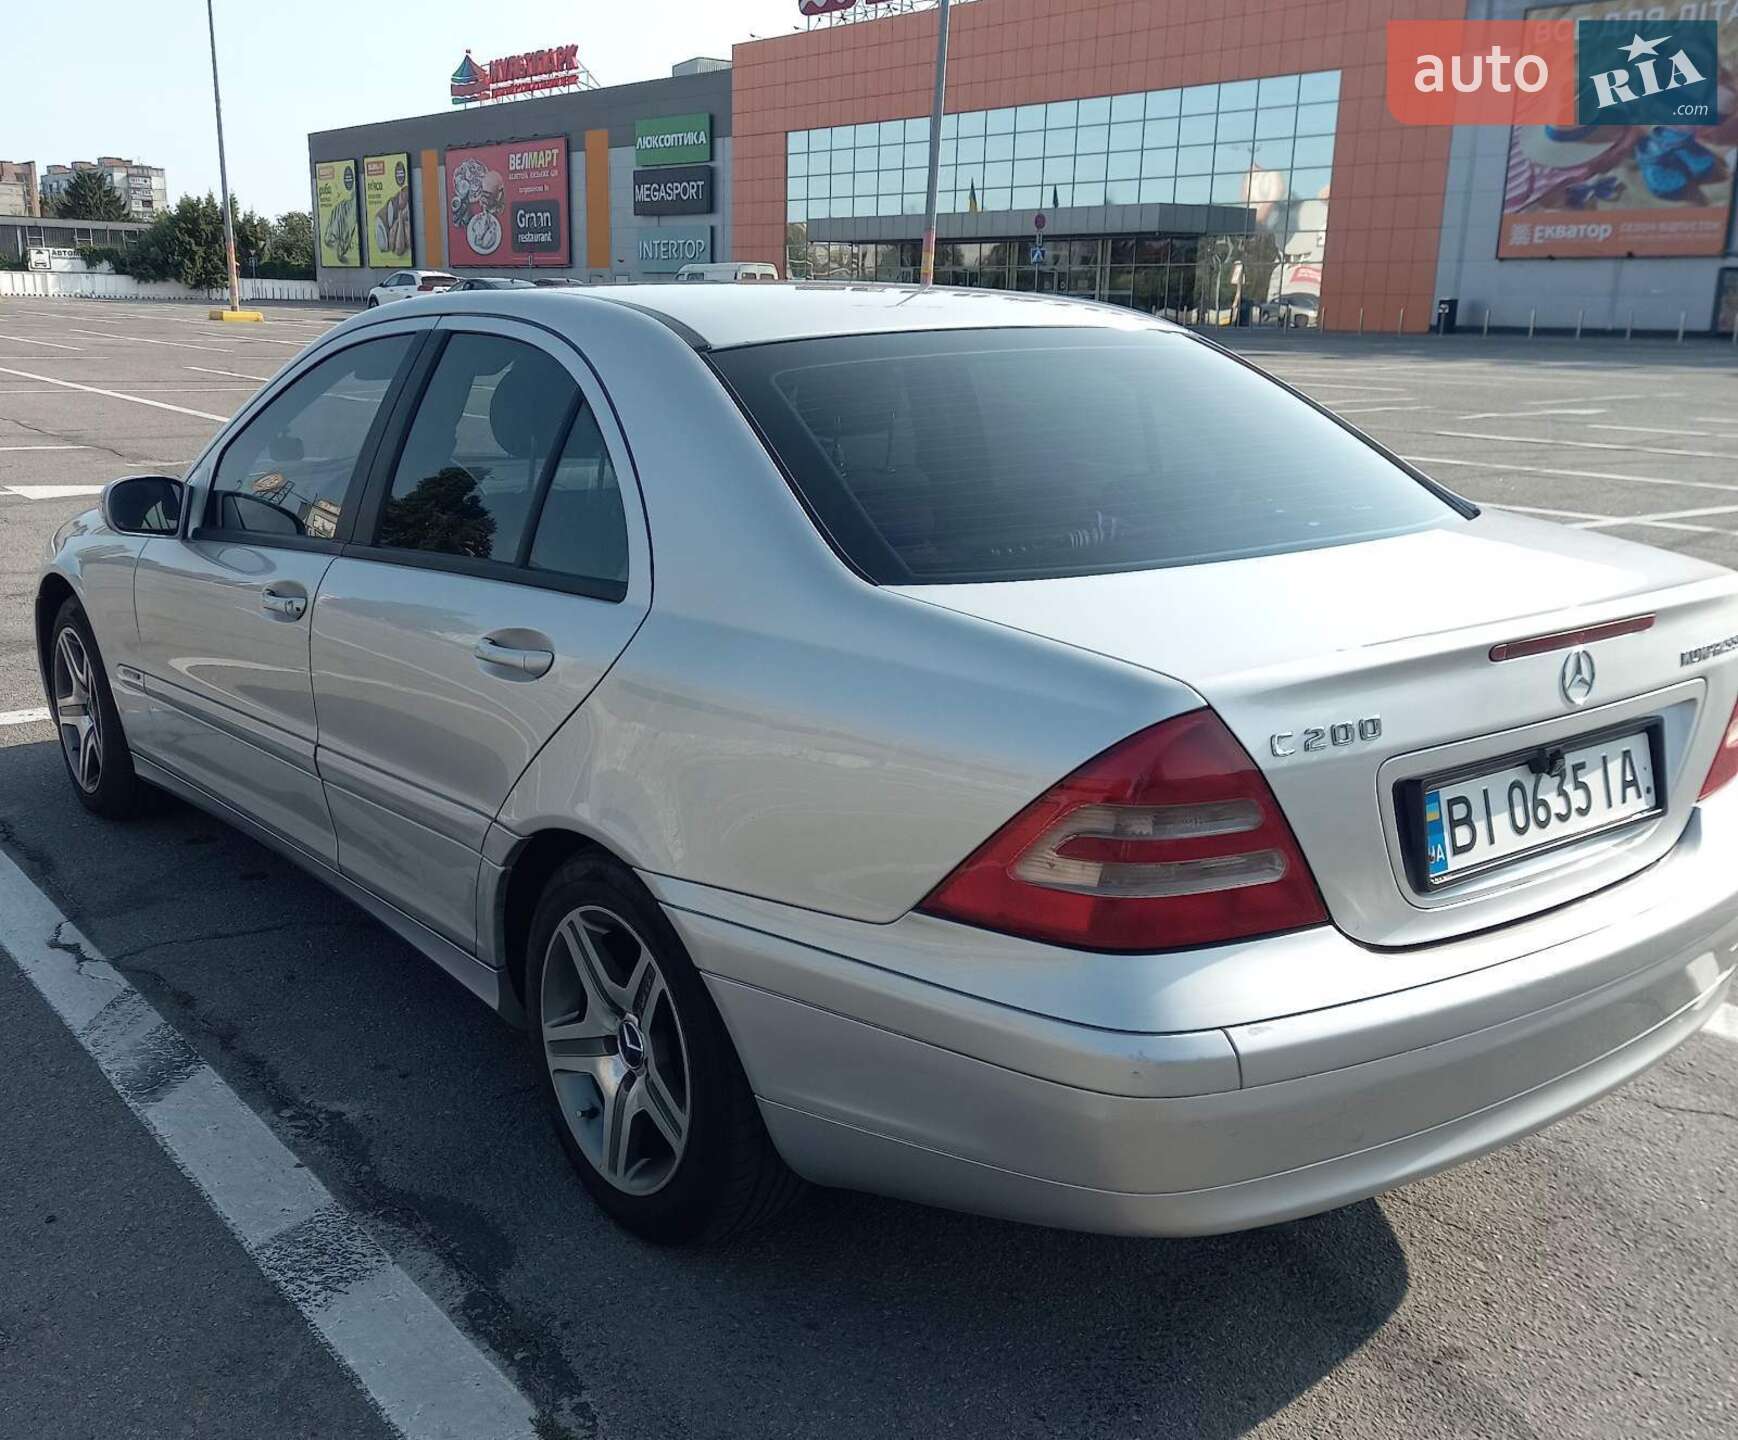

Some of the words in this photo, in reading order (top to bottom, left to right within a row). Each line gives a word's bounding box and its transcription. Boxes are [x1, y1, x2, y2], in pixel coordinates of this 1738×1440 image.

[636, 131, 707, 149] ЛЮКСОПТИКА
[508, 149, 559, 171] ВЕЛМАРТ
[635, 181, 704, 202] MEGASPORT
[518, 230, 552, 243] restaurant
[639, 239, 705, 260] INTERTOP
[1270, 731, 1297, 757] C
[1303, 714, 1382, 752] 200
[1447, 786, 1496, 857] BI
[1507, 761, 1593, 836] 0635
[1601, 749, 1643, 810] IA
